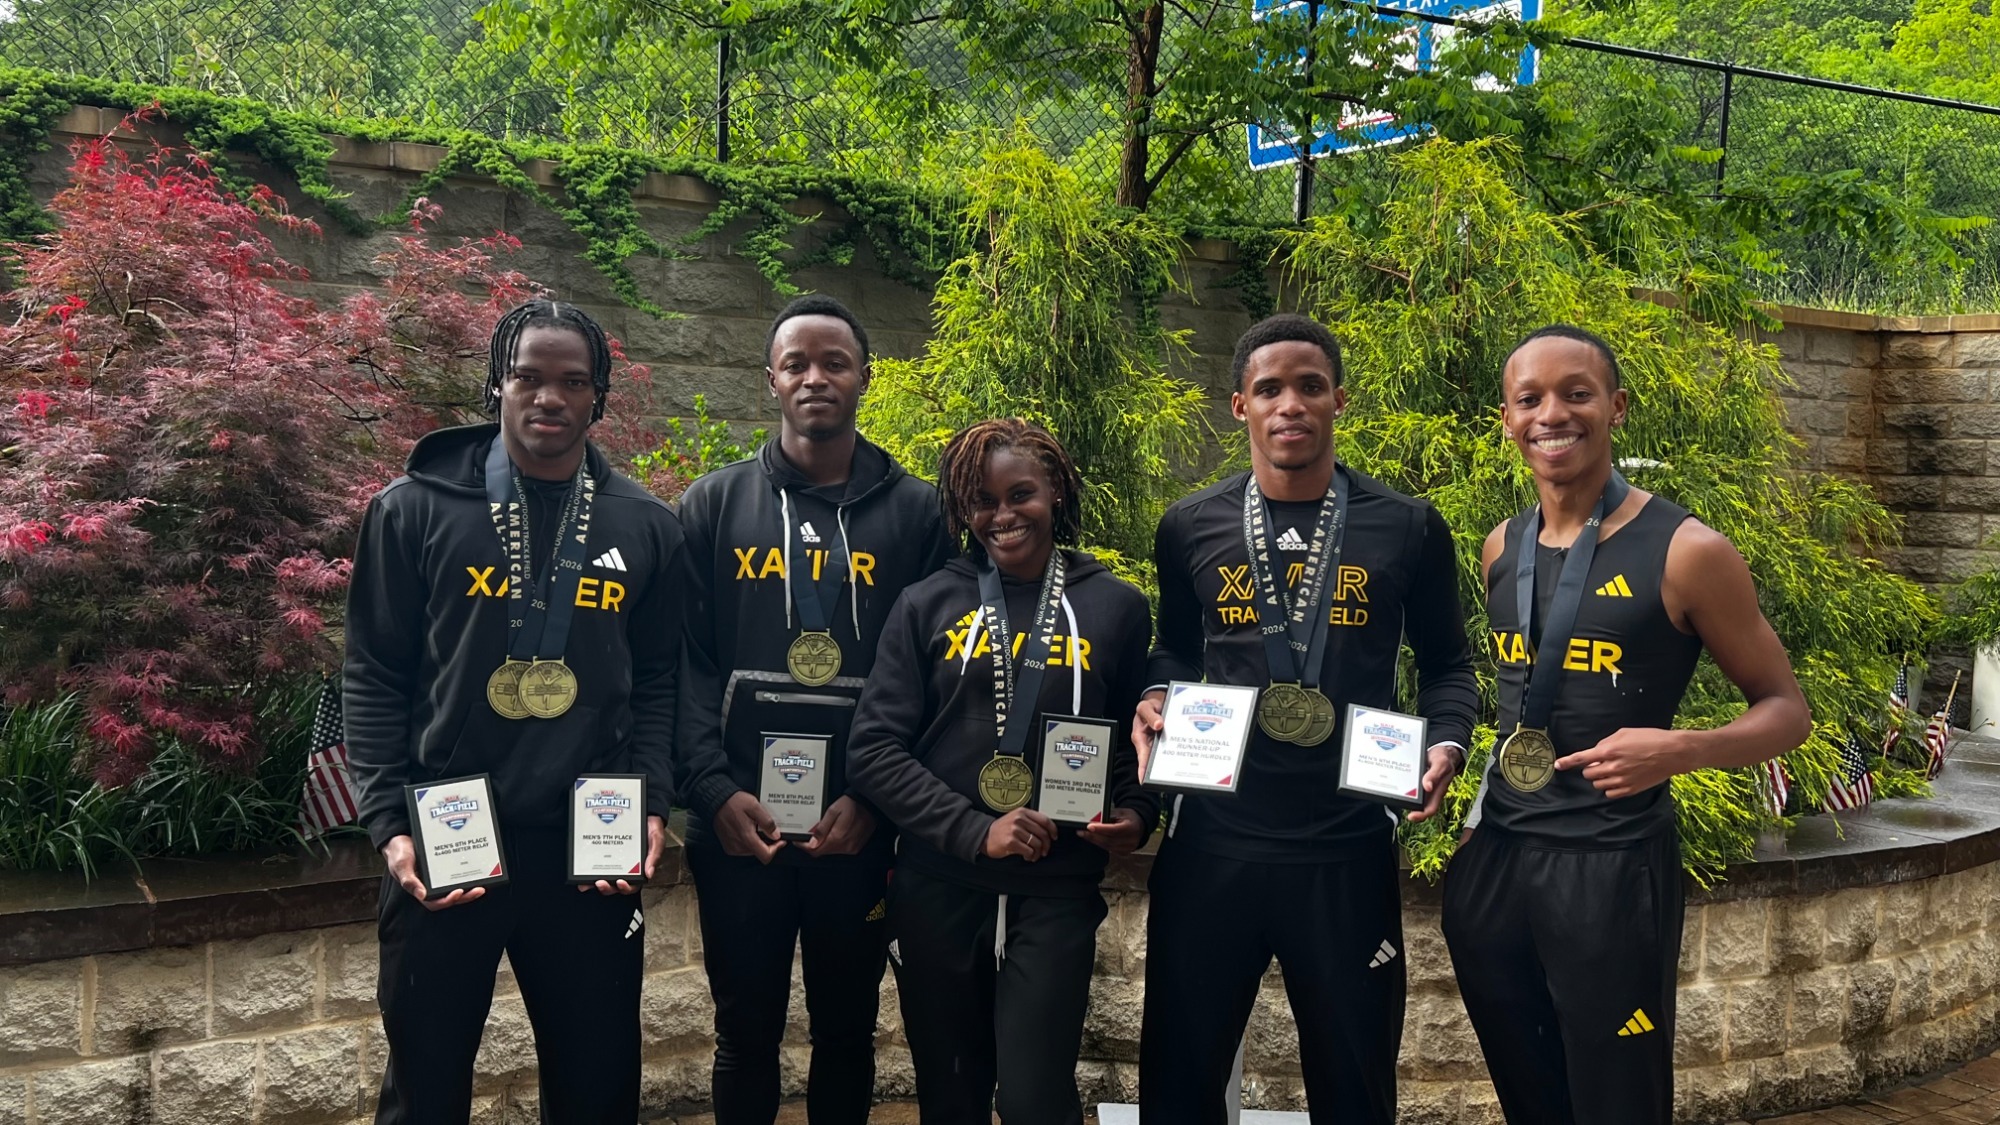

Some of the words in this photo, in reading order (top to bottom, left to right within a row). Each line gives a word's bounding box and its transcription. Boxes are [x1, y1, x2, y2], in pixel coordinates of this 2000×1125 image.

[513, 477, 522, 494] NAIA
[519, 494, 529, 531] OUTDOOR
[1331, 509, 1340, 524] NAIA
[1323, 525, 1337, 559] OUTDOOR
[508, 502, 522, 599] AMERICAN
[1292, 488, 1336, 622] ALL-AMERICAN
[560, 559, 582, 571] 2026
[733, 547, 876, 586] XAIR
[1316, 559, 1328, 581] TRACK
[1310, 587, 1320, 606] FIELD
[1036, 610, 1044, 625] NAIA
[1217, 606, 1260, 624] TRA
[1329, 607, 1368, 625] ELD
[1262, 623, 1285, 635] 2026
[1003, 635, 1013, 669] OUTDOOR
[1493, 632, 1623, 674] XAER
[1024, 658, 1045, 670] 2026
[1006, 669, 1014, 692] TRACK
[1056, 742, 1077, 752] TRACK
[1080, 745, 1098, 755] FIELD
[1195, 738, 1231, 747] NATIONAL
[774, 758, 794, 767] TRACK
[797, 759, 814, 768] FIELD
[1045, 778, 1071, 786] WOMEN'S
[1076, 787, 1101, 795] HURDLES
[468, 837, 487, 845] PLACE
[472, 842, 489, 850] RELAY
